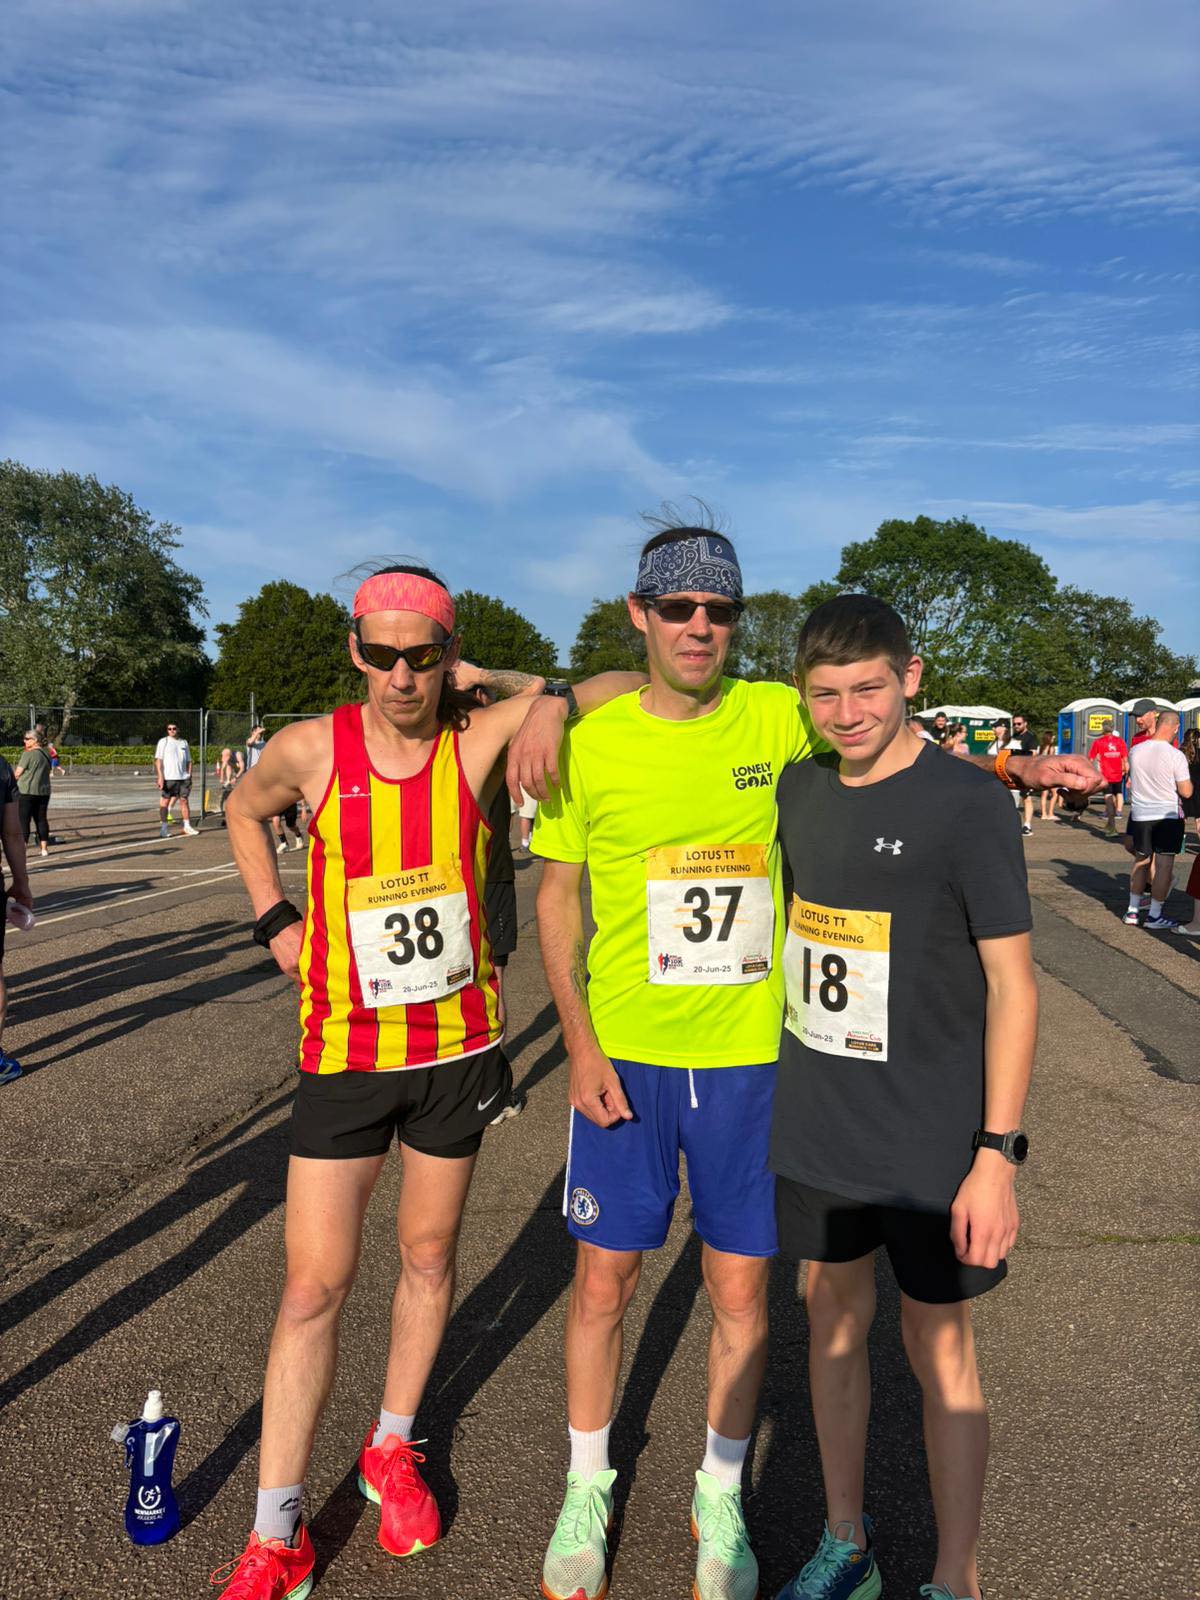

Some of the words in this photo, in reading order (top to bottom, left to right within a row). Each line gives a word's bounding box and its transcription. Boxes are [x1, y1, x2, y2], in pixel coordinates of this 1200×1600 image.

[732, 761, 771, 777] LONELY
[735, 773, 773, 790] GOAT
[686, 850, 721, 861] LOTUS
[723, 850, 735, 860] TT
[670, 866, 712, 875] RUNNING
[715, 864, 751, 873] EVENING
[381, 874, 416, 890] LOTUS
[418, 872, 429, 882] TT
[368, 891, 408, 904] RUNNING
[411, 883, 447, 897] EVENING
[683, 886, 744, 943] 37
[801, 908, 830, 925] LOTUS
[833, 916, 847, 928] TT
[384, 906, 444, 966] 38
[822, 930, 864, 944] EVENING
[693, 965, 732, 973] 20-Jun-25
[402, 981, 438, 993] 20-Jun-25
[803, 946, 848, 1013] 18
